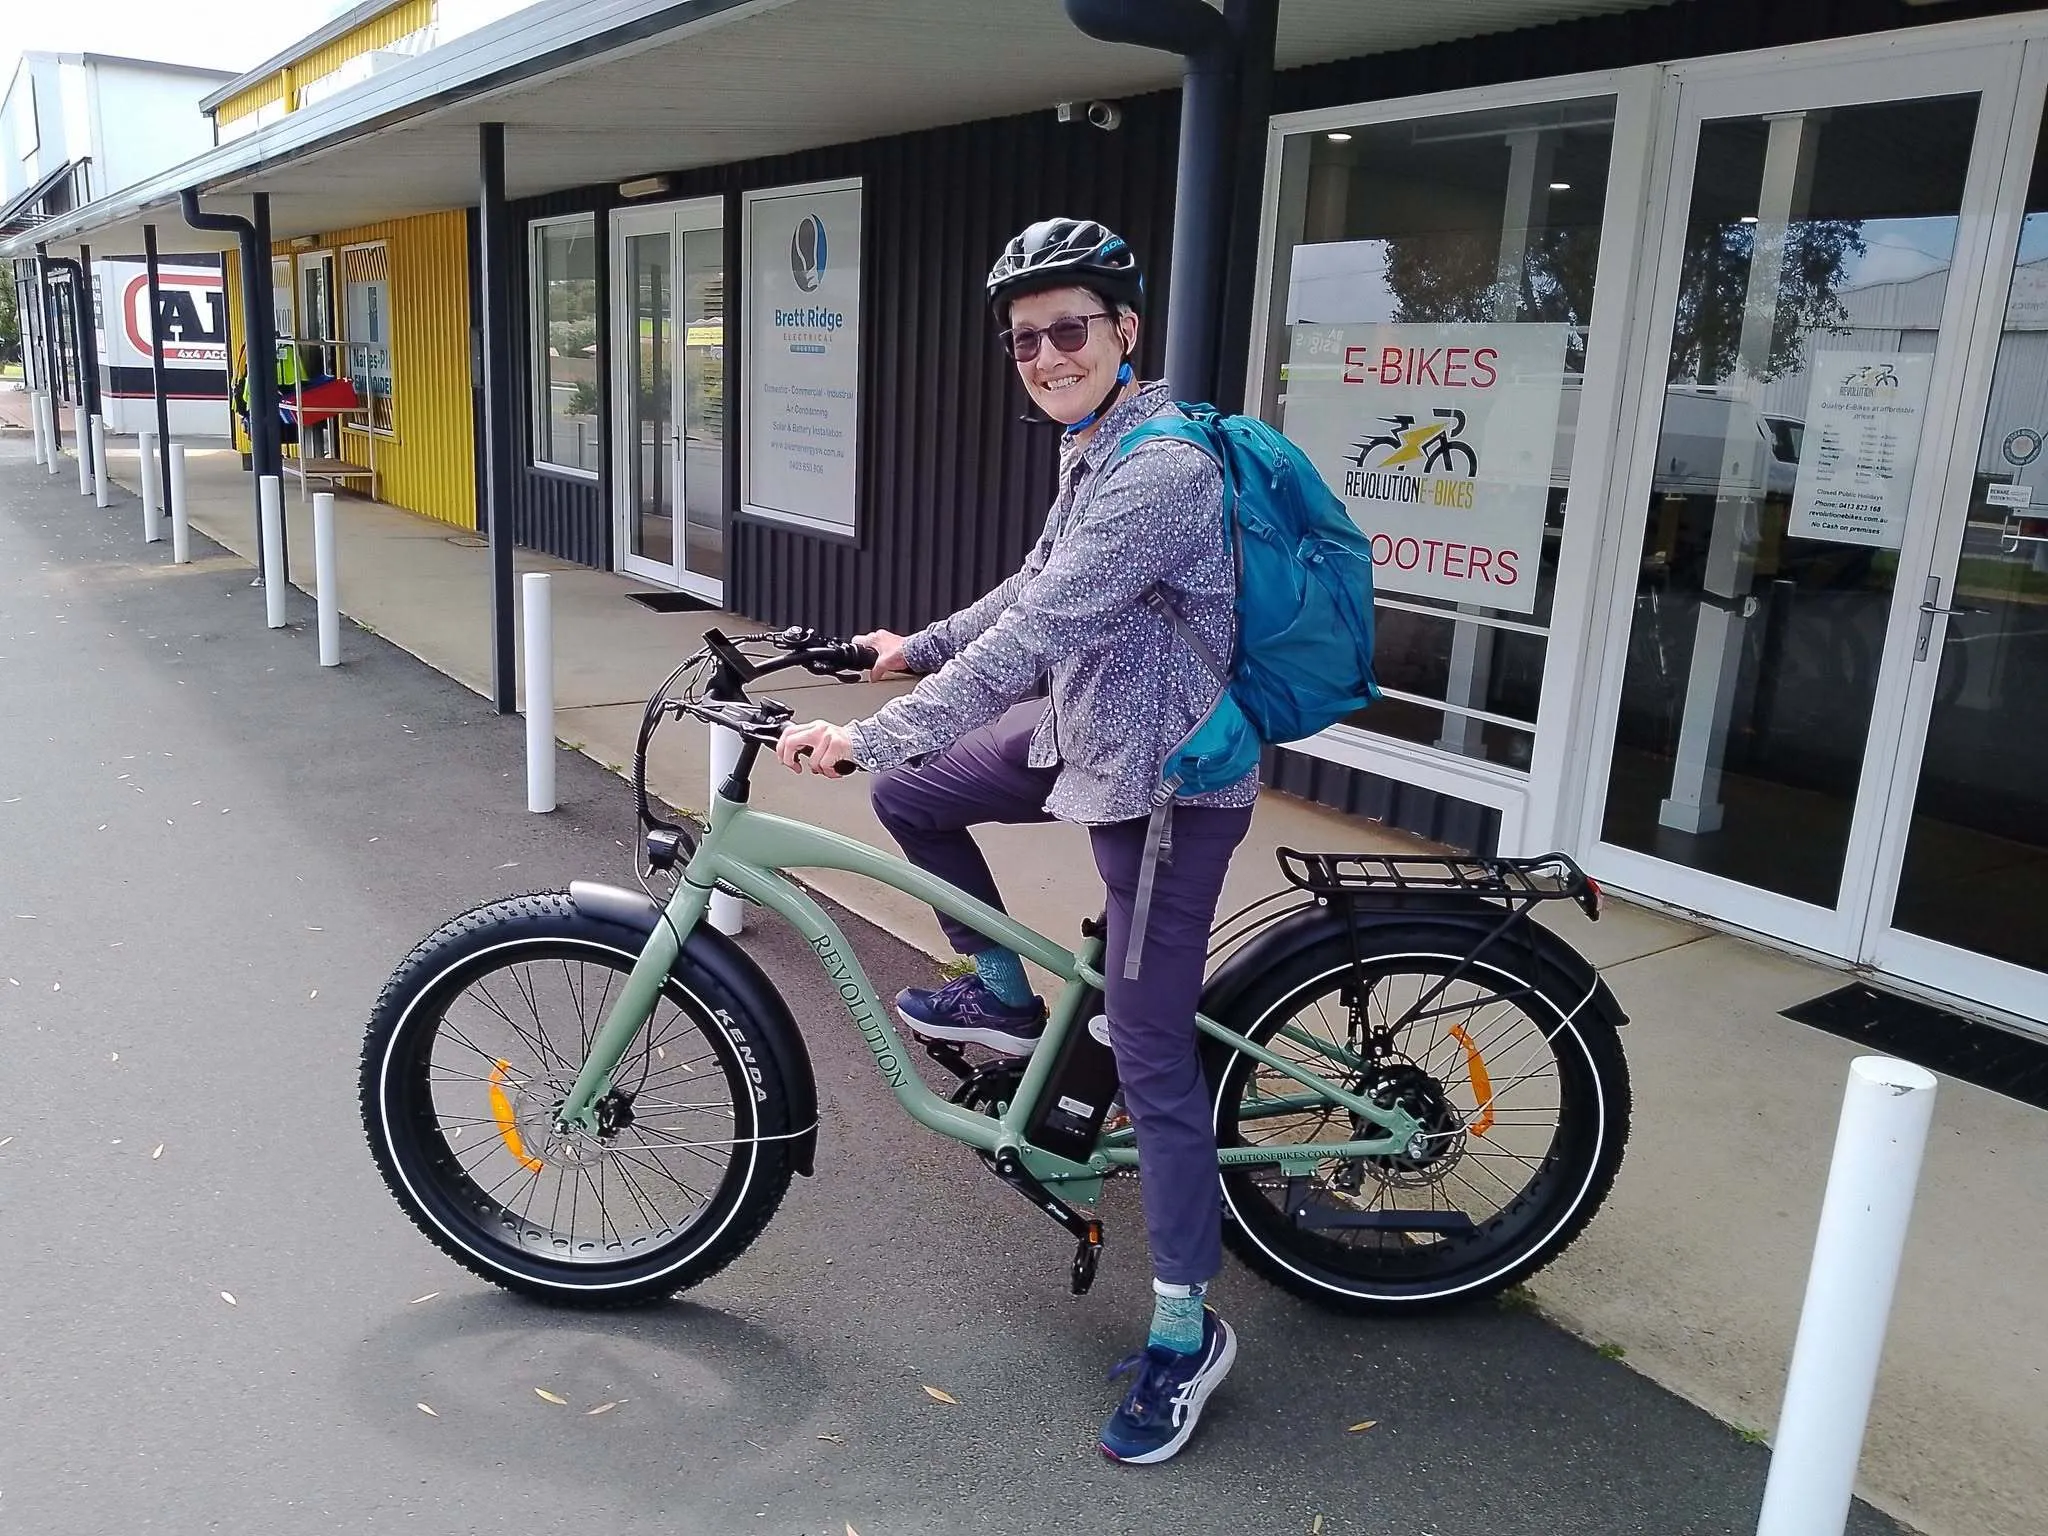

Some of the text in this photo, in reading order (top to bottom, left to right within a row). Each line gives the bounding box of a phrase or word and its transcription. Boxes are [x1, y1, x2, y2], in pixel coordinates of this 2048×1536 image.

[1100, 239, 1125, 257] ADU
[775, 305, 843, 332] Brett Ridge
[783, 333, 833, 342] ELECTRICAL
[1343, 347, 1498, 388] E-BIKES
[812, 425, 842, 438] Installation
[1816, 488, 1837, 496] Closed
[1857, 491, 1883, 501] Holidays
[1814, 500, 1838, 509] Phone:
[1809, 510, 1889, 524] revolutionebikes.com.au
[1822, 522, 1839, 530] Cash
[1849, 526, 1881, 535] premises
[1372, 533, 1520, 585] OOTERS
[810, 933, 909, 1088] REVOLUTION
[715, 1009, 767, 1102] KENDA
[1219, 1148, 1347, 1163] VOLUTIONEBIKES.COM.AU
